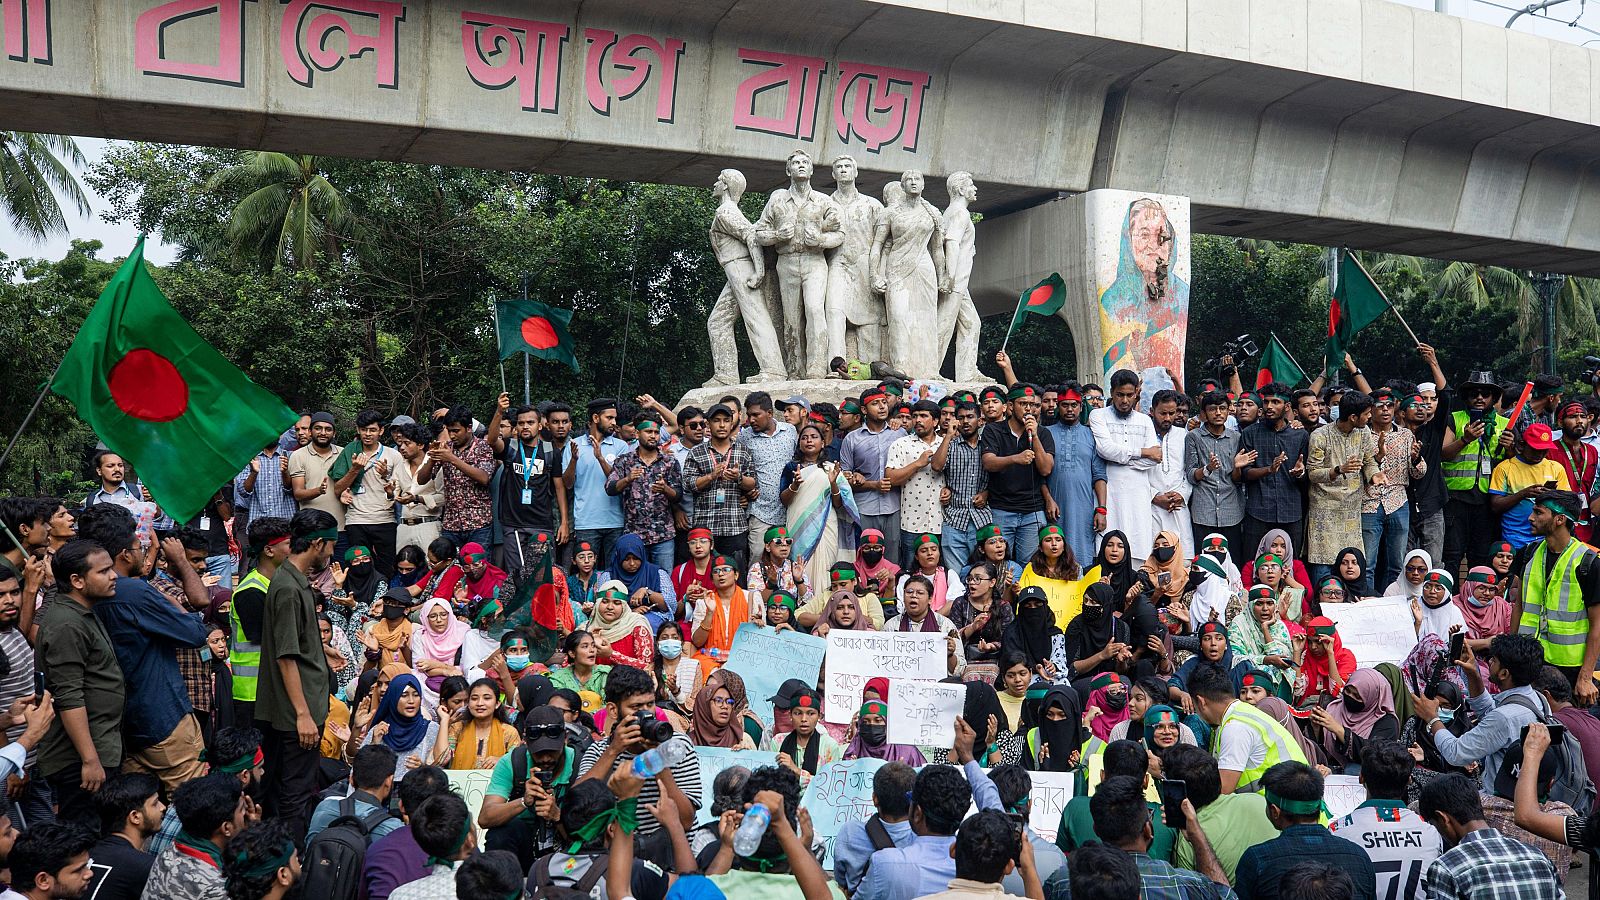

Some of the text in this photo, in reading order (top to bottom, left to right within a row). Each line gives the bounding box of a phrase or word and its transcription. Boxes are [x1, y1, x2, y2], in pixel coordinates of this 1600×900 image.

[461, 11, 686, 124] আগে
[734, 48, 931, 153] বাড়ো
[892, 635, 916, 654] ফিরে
[917, 636, 937, 654] এই
[919, 720, 945, 738] চাই
[815, 763, 857, 806] খুনি
